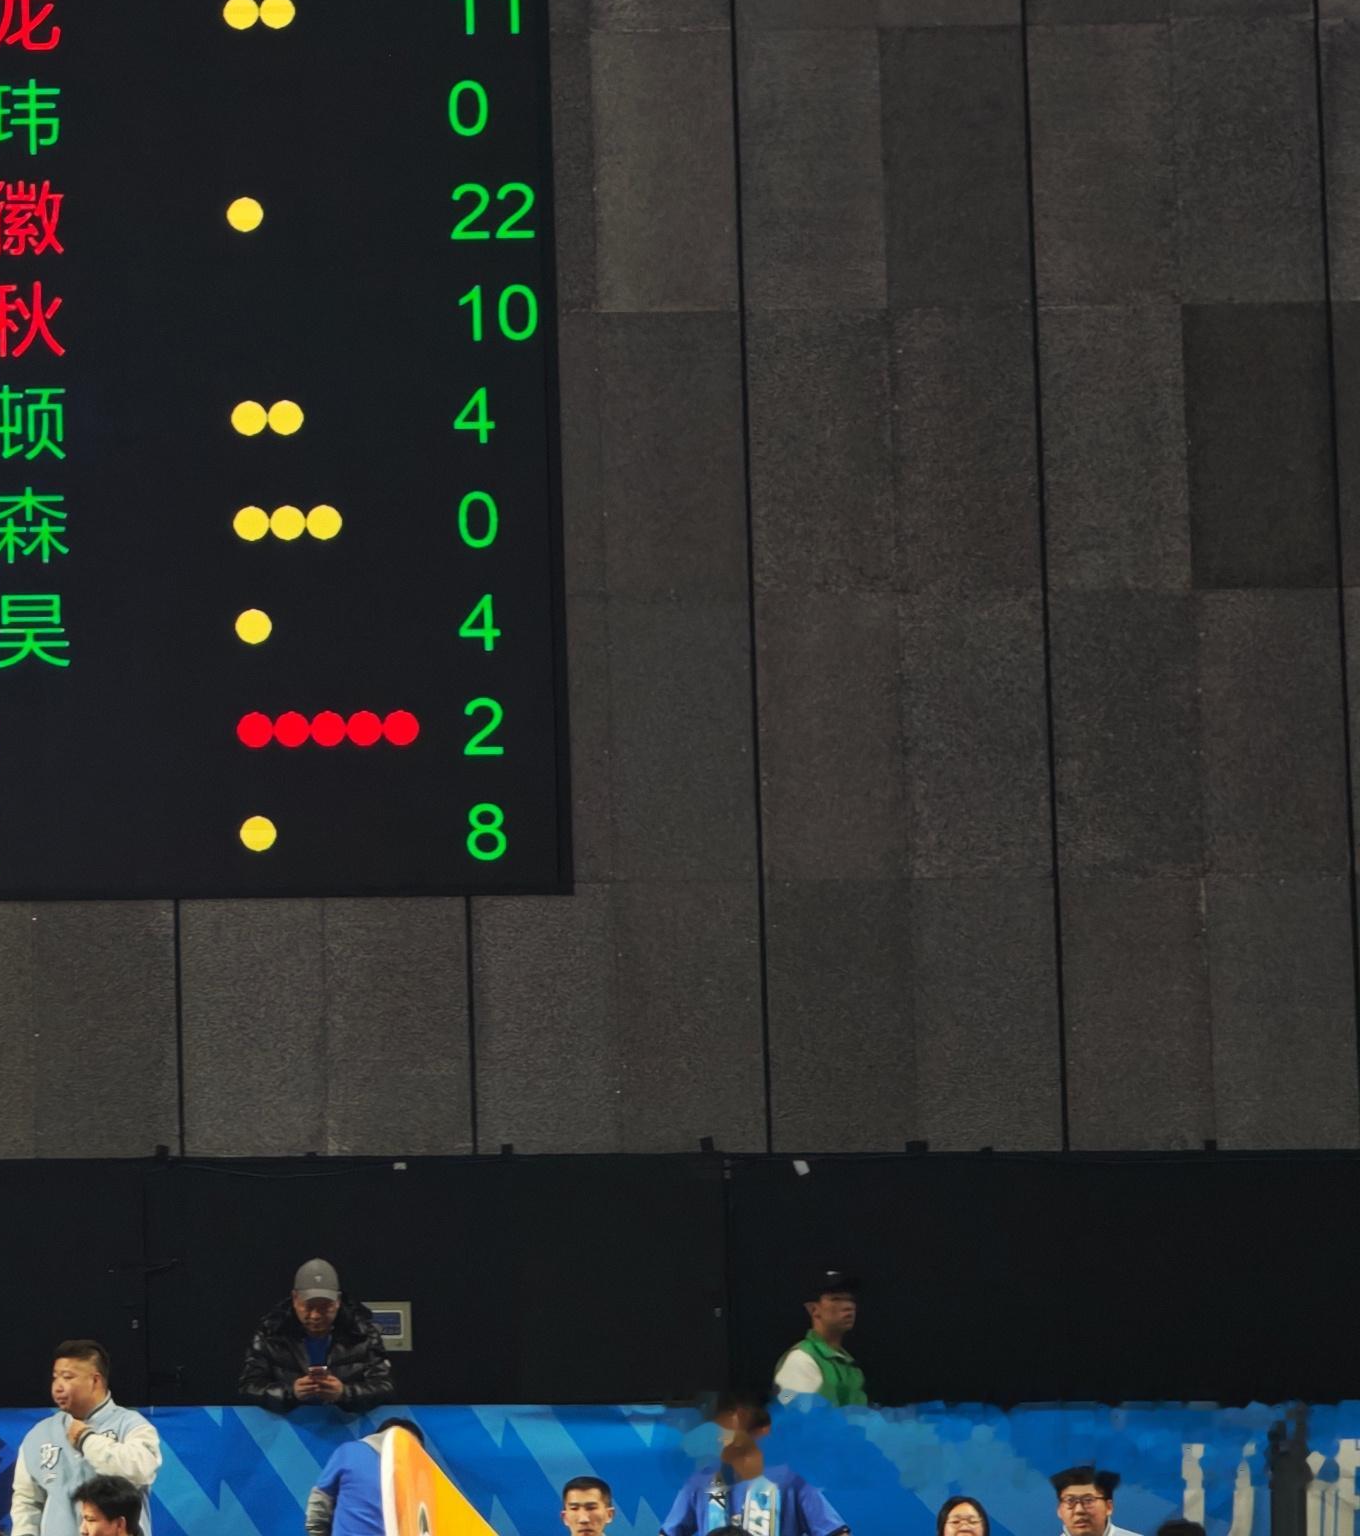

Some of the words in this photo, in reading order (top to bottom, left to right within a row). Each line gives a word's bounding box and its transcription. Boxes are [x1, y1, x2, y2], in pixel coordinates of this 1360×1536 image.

[448, 79, 488, 137] 0
[450, 182, 536, 240] 22
[458, 284, 539, 342] 10
[453, 387, 496, 444] 4
[458, 490, 499, 549] 0
[458, 593, 501, 652] 4
[463, 697, 504, 756] 2
[466, 803, 507, 861] 8
